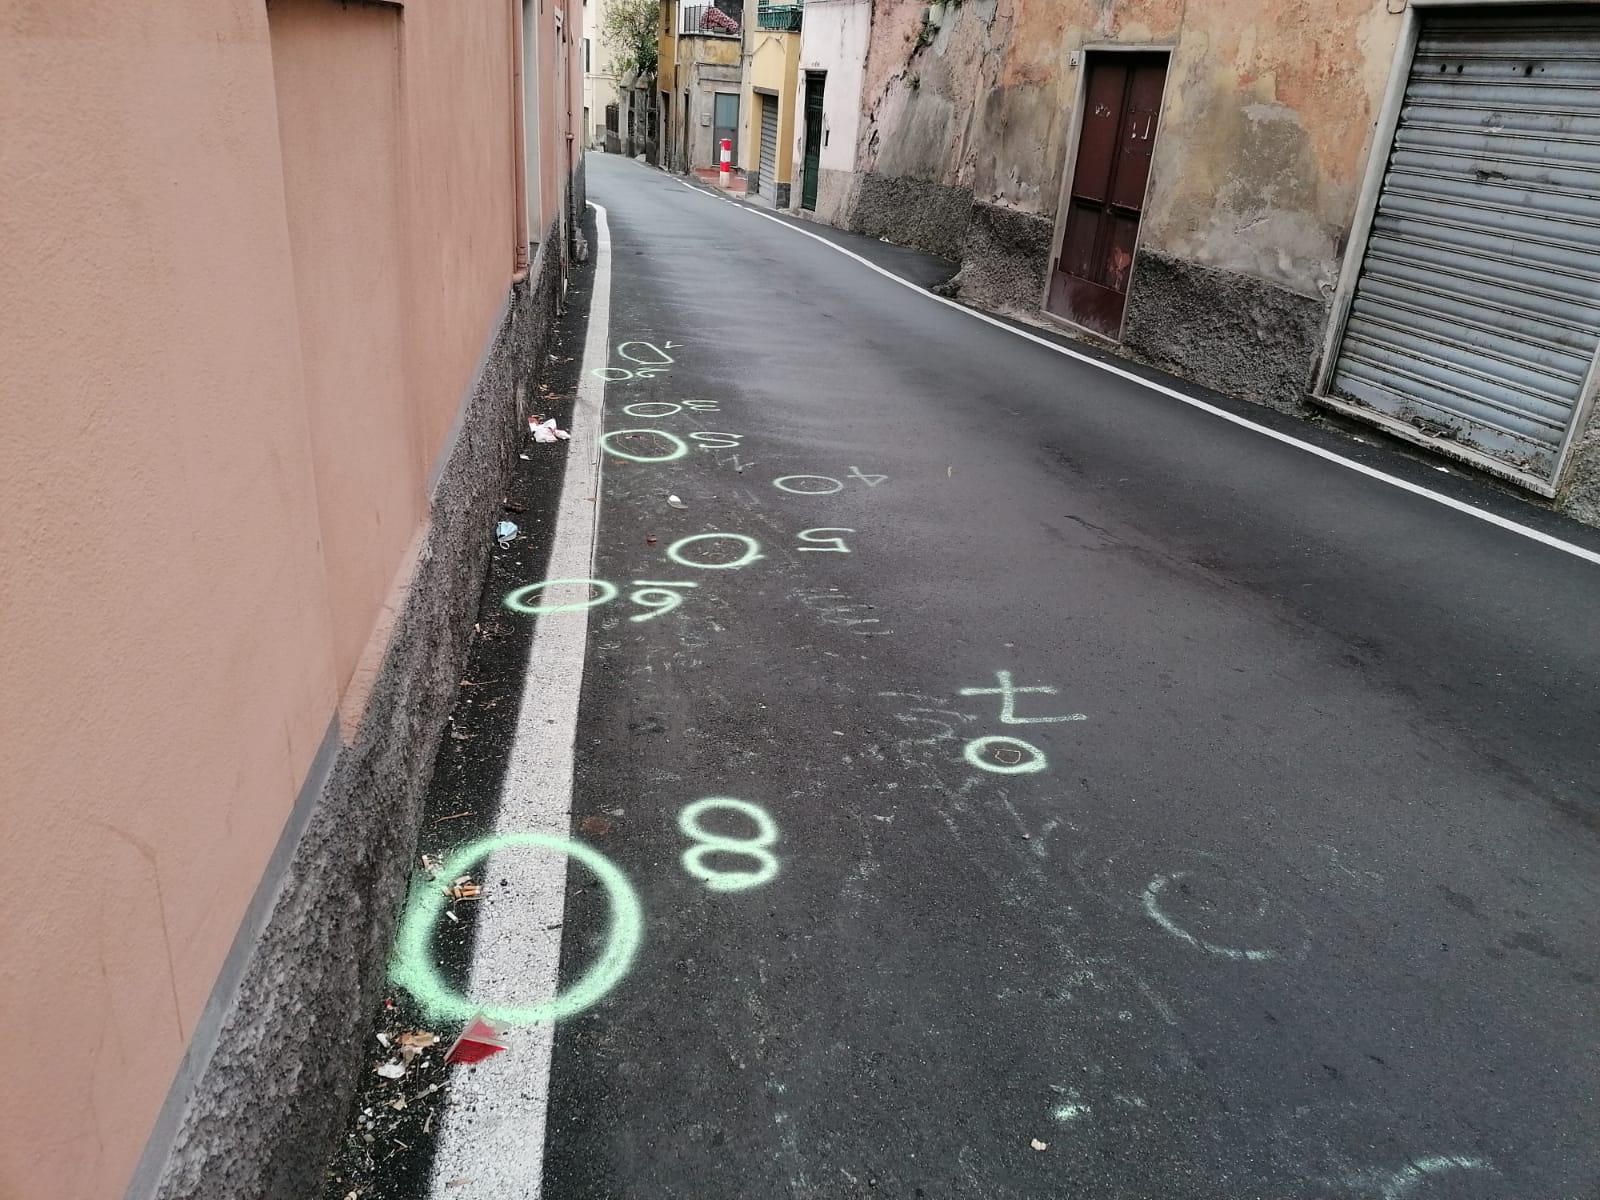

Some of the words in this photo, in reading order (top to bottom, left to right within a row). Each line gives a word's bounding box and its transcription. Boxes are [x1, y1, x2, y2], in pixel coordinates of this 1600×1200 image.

[682, 399, 720, 412] 3
[847, 465, 889, 487] 4
[796, 527, 856, 554] 5
[629, 579, 699, 623] 6
[958, 670, 1088, 726] 7
[676, 796, 782, 893] 8
